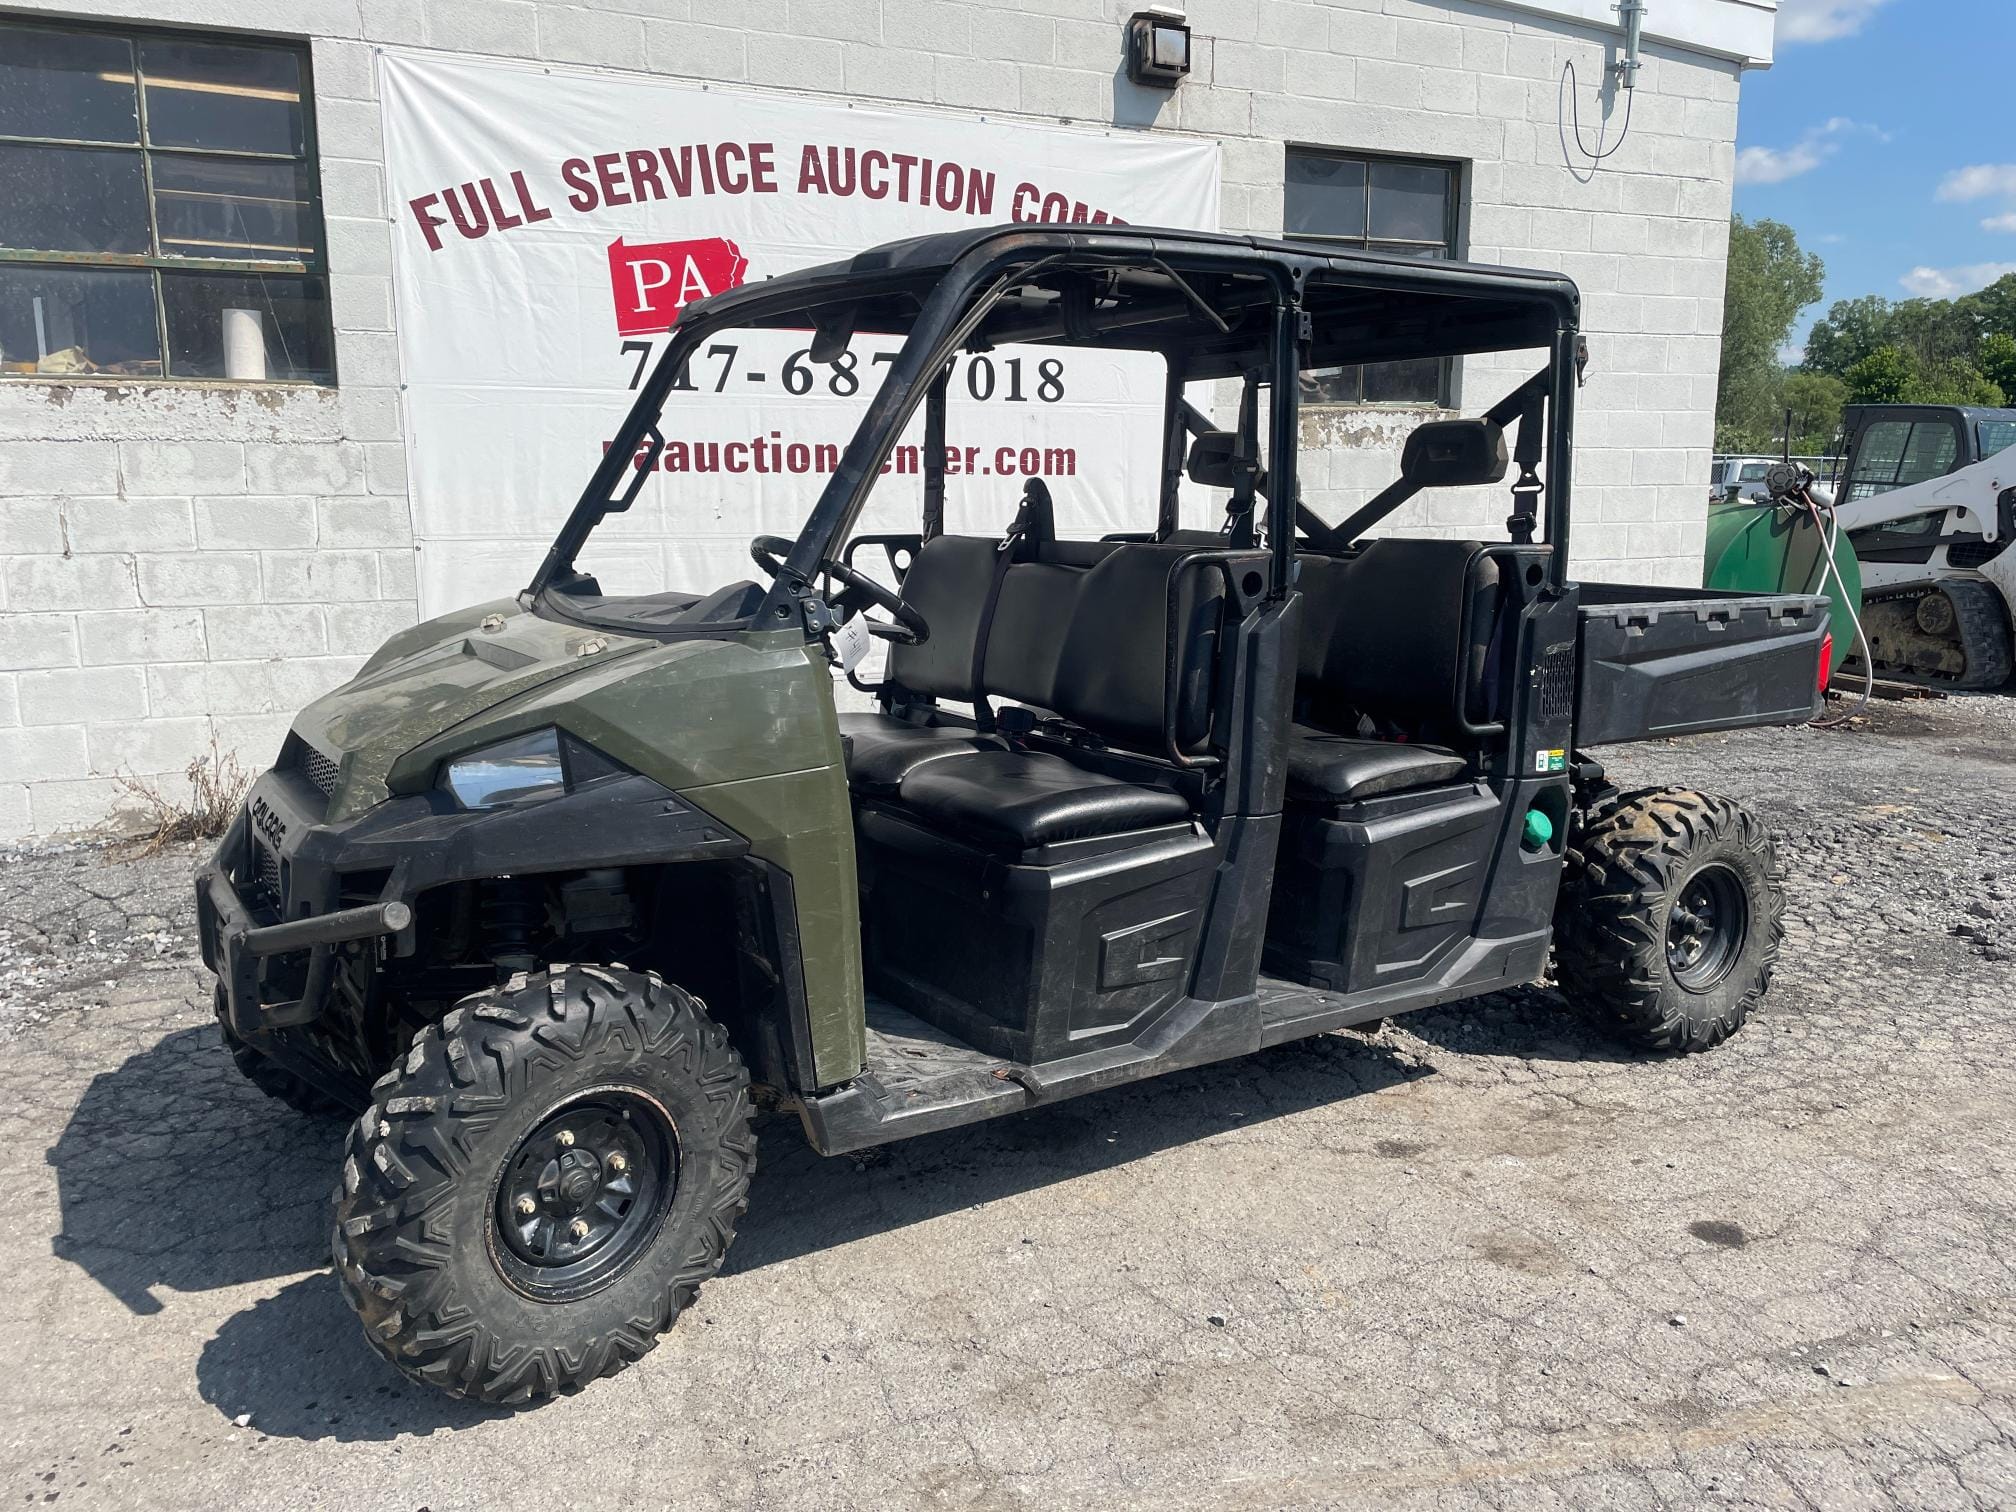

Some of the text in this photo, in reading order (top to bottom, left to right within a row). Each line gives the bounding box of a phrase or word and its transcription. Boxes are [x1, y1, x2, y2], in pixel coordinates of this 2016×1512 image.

[409, 170, 553, 252] FULL
[561, 142, 778, 213] SERVICE
[797, 144, 996, 215] AUCTION
[626, 254, 714, 313] PA
